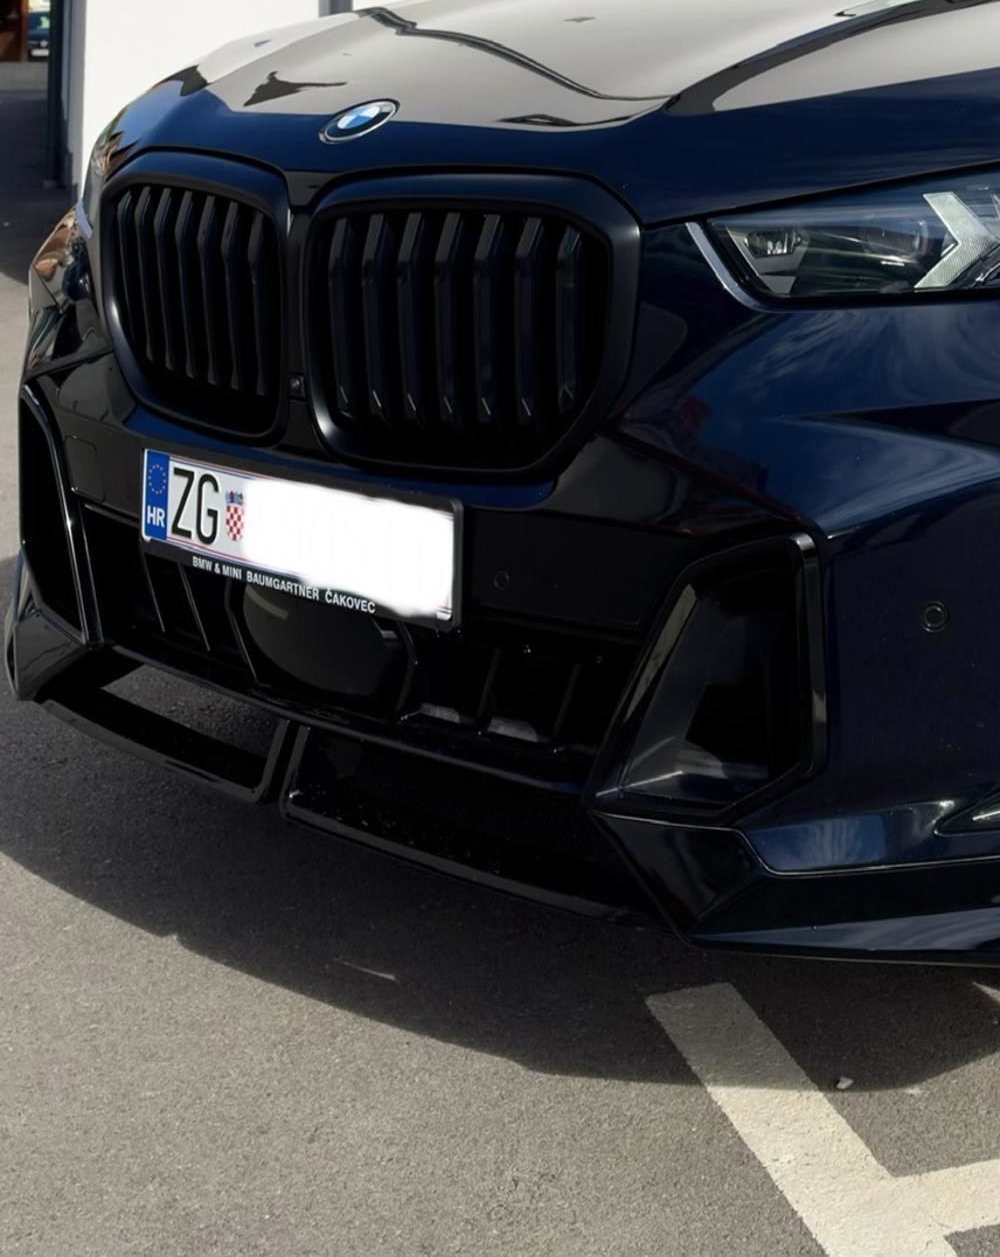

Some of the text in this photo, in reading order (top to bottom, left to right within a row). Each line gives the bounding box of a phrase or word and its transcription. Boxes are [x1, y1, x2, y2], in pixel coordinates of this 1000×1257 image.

[146, 505, 165, 528] HR
[171, 467, 219, 545] ZG
[192, 556, 376, 614] BMW & MINI BAUMGARTNER ČAKOVEC
